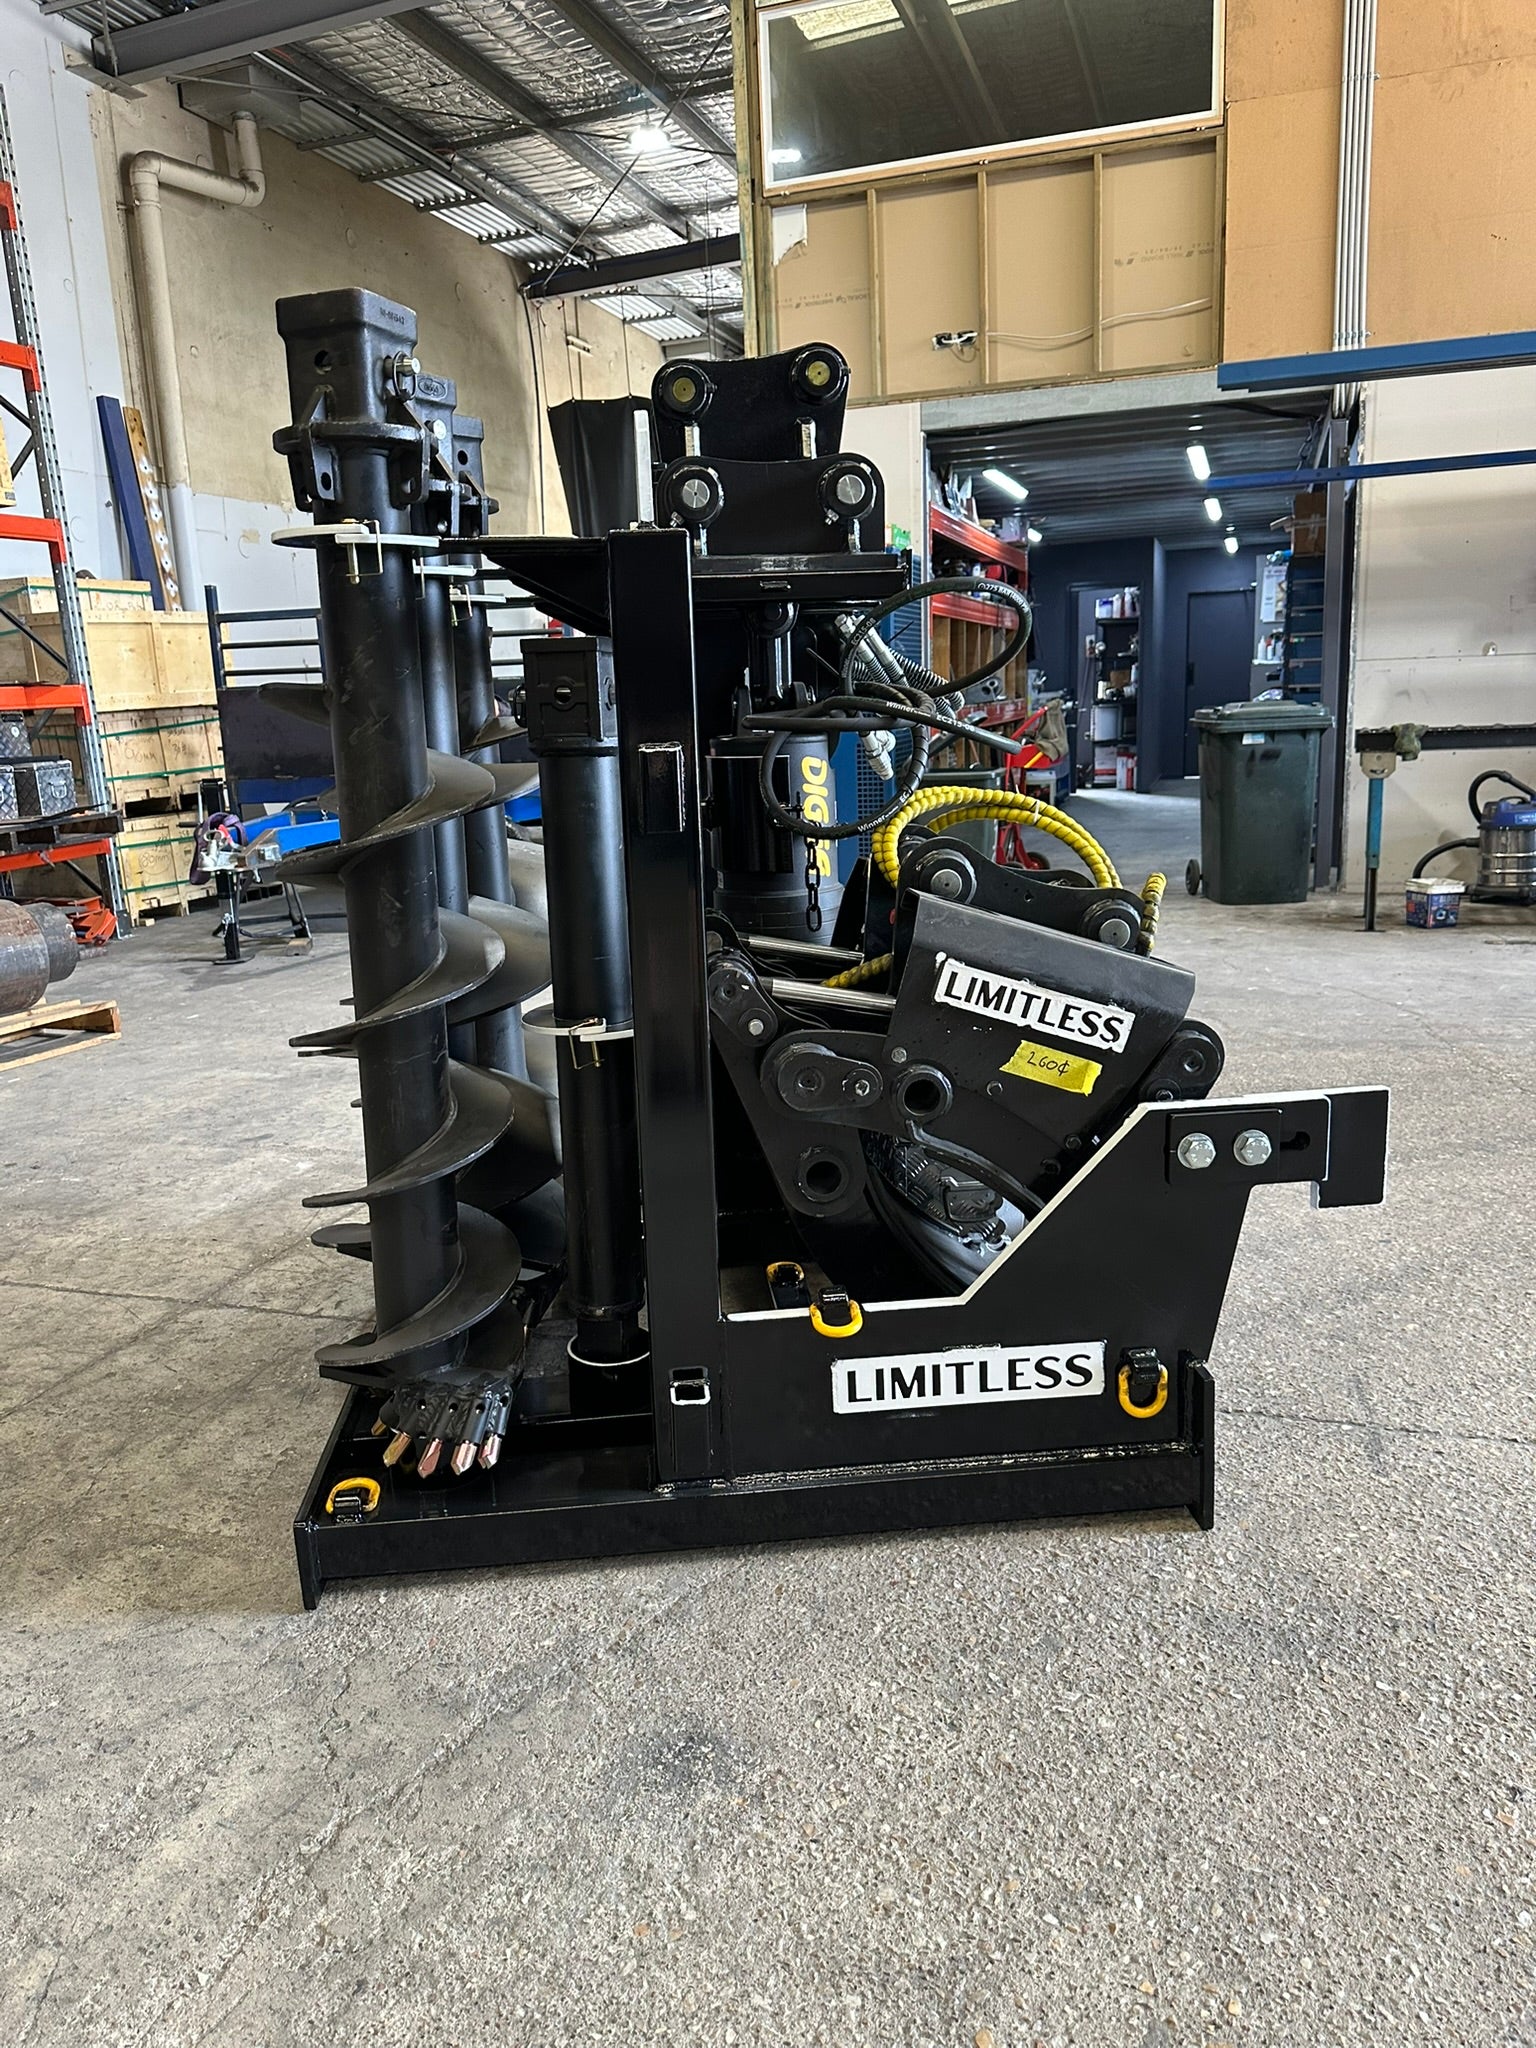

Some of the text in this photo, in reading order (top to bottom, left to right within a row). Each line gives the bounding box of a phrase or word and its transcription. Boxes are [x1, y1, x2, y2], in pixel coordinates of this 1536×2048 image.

[986, 583, 998, 591] 275
[885, 701, 915, 713] Winner
[936, 714, 975, 732] EC215-08
[857, 814, 886, 833] Winner
[943, 971, 1126, 1045] LIMITLESS
[847, 1353, 1094, 1404] LIMITLESS
